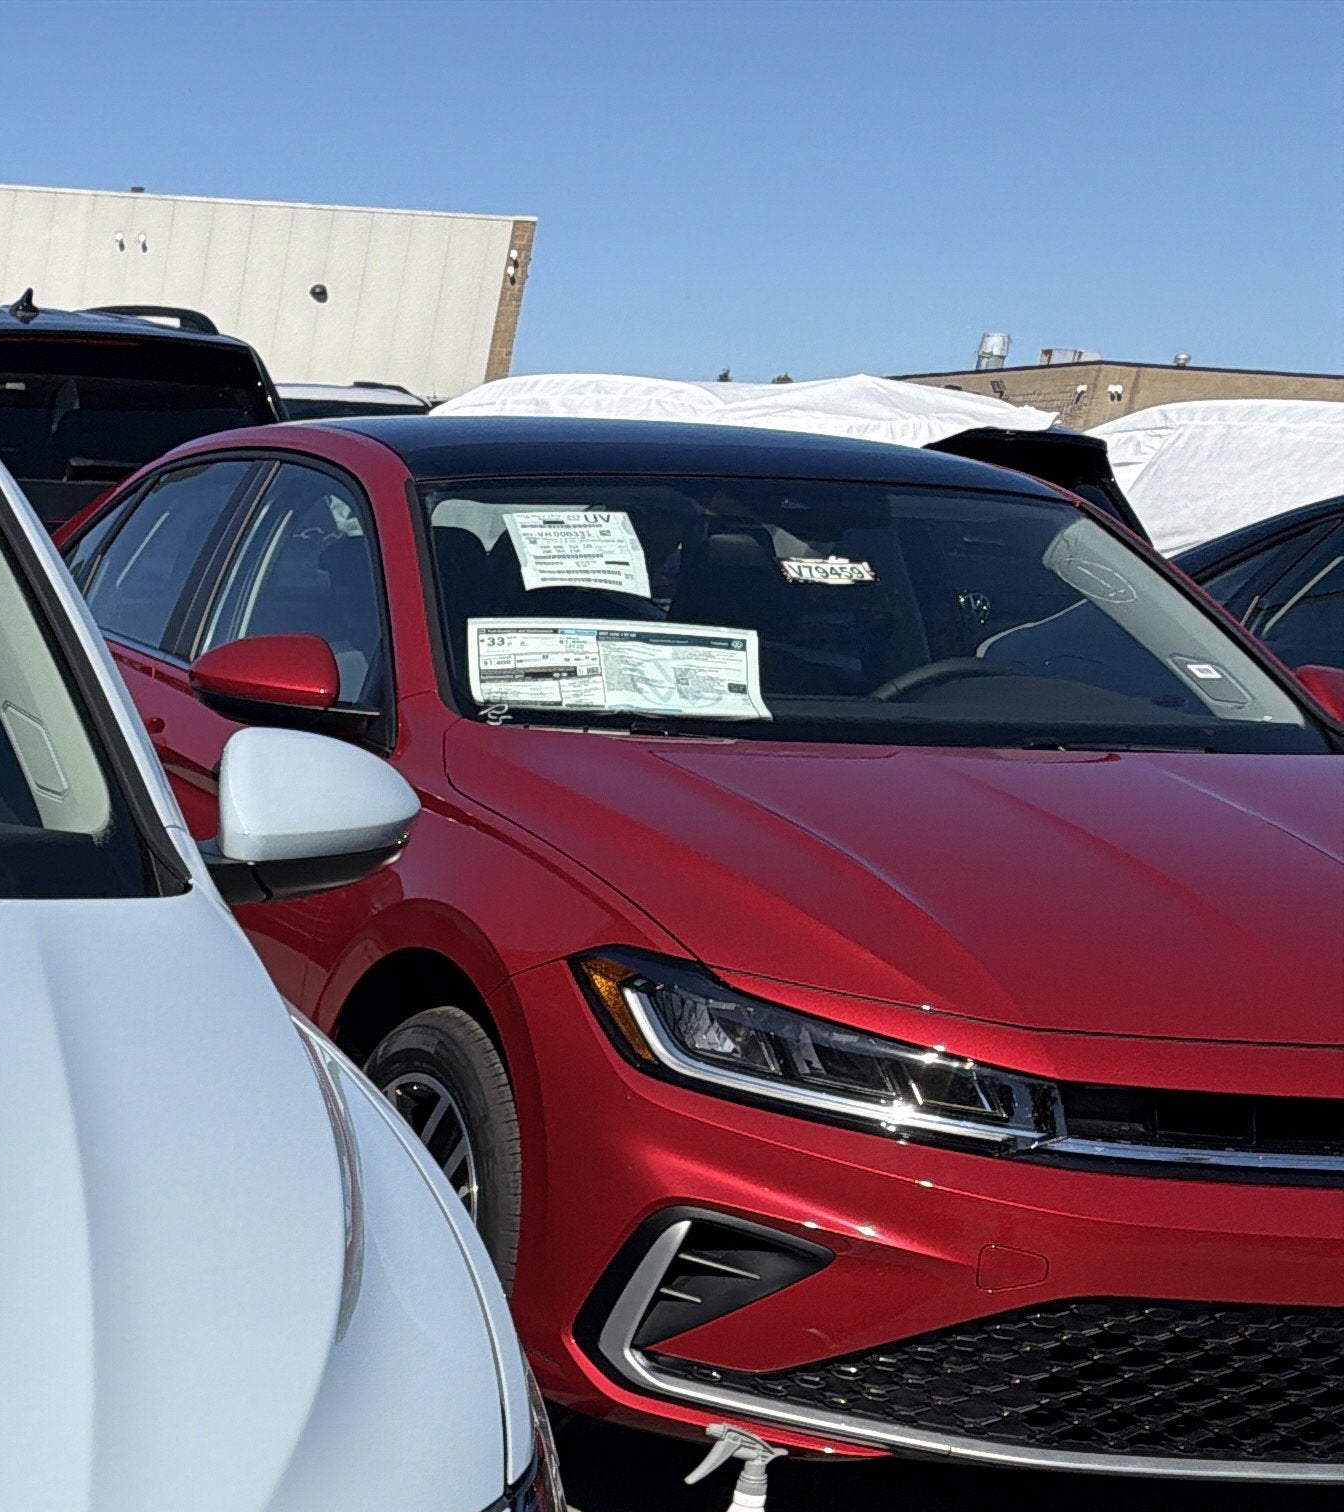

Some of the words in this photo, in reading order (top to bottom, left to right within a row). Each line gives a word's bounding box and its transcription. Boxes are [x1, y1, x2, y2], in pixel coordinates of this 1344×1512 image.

[584, 514, 611, 523] UV
[787, 565, 865, 579] V79459
[487, 637, 505, 646] 33
